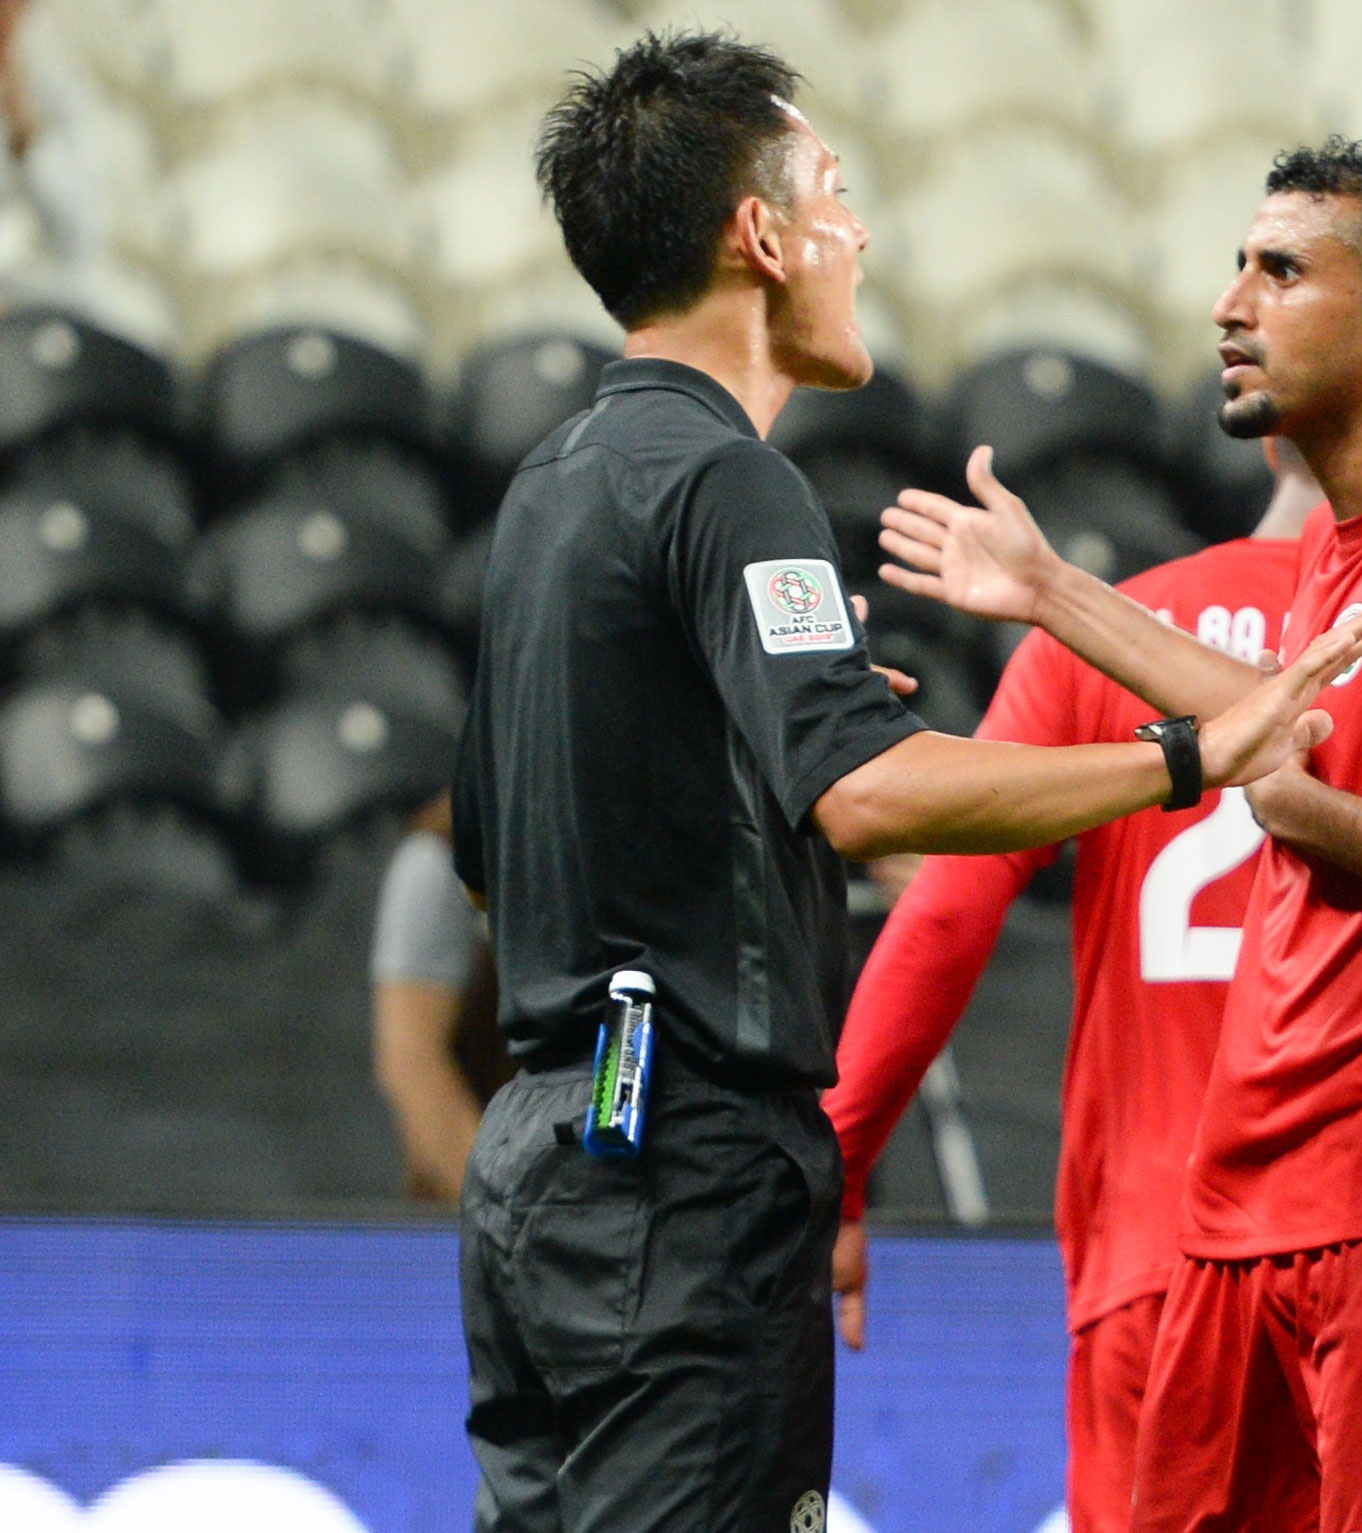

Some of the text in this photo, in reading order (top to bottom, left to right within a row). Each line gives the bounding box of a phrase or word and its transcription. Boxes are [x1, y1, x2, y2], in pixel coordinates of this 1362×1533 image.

[792, 615, 815, 624] AFC
[769, 623, 842, 636] ASIAN CUP
